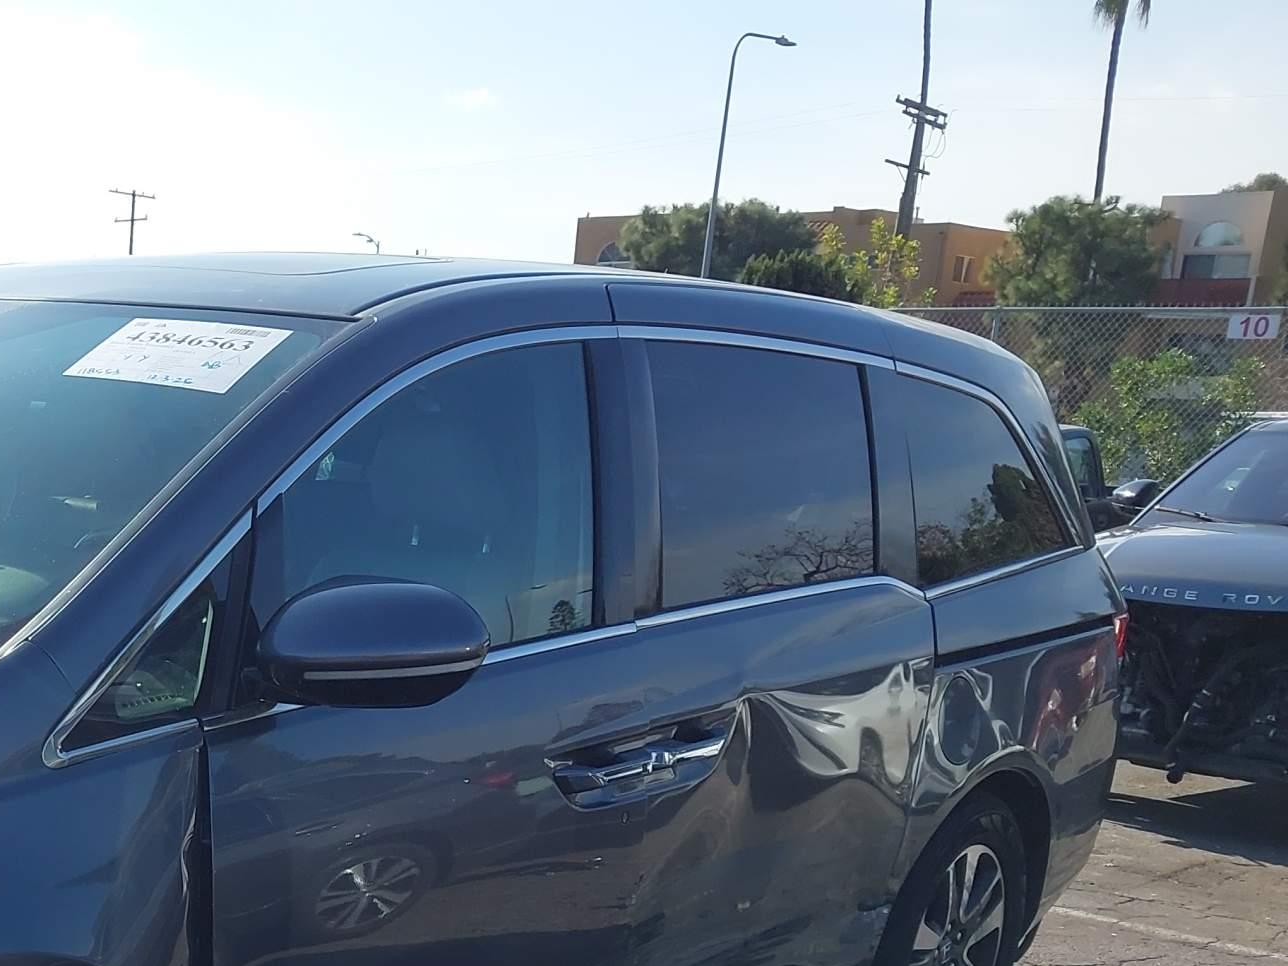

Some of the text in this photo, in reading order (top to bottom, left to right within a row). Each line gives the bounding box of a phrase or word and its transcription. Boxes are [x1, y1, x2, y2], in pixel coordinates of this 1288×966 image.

[1240, 316, 1270, 338] 10
[125, 330, 255, 352] 43846563
[1118, 584, 1285, 605] ANGE ROV
